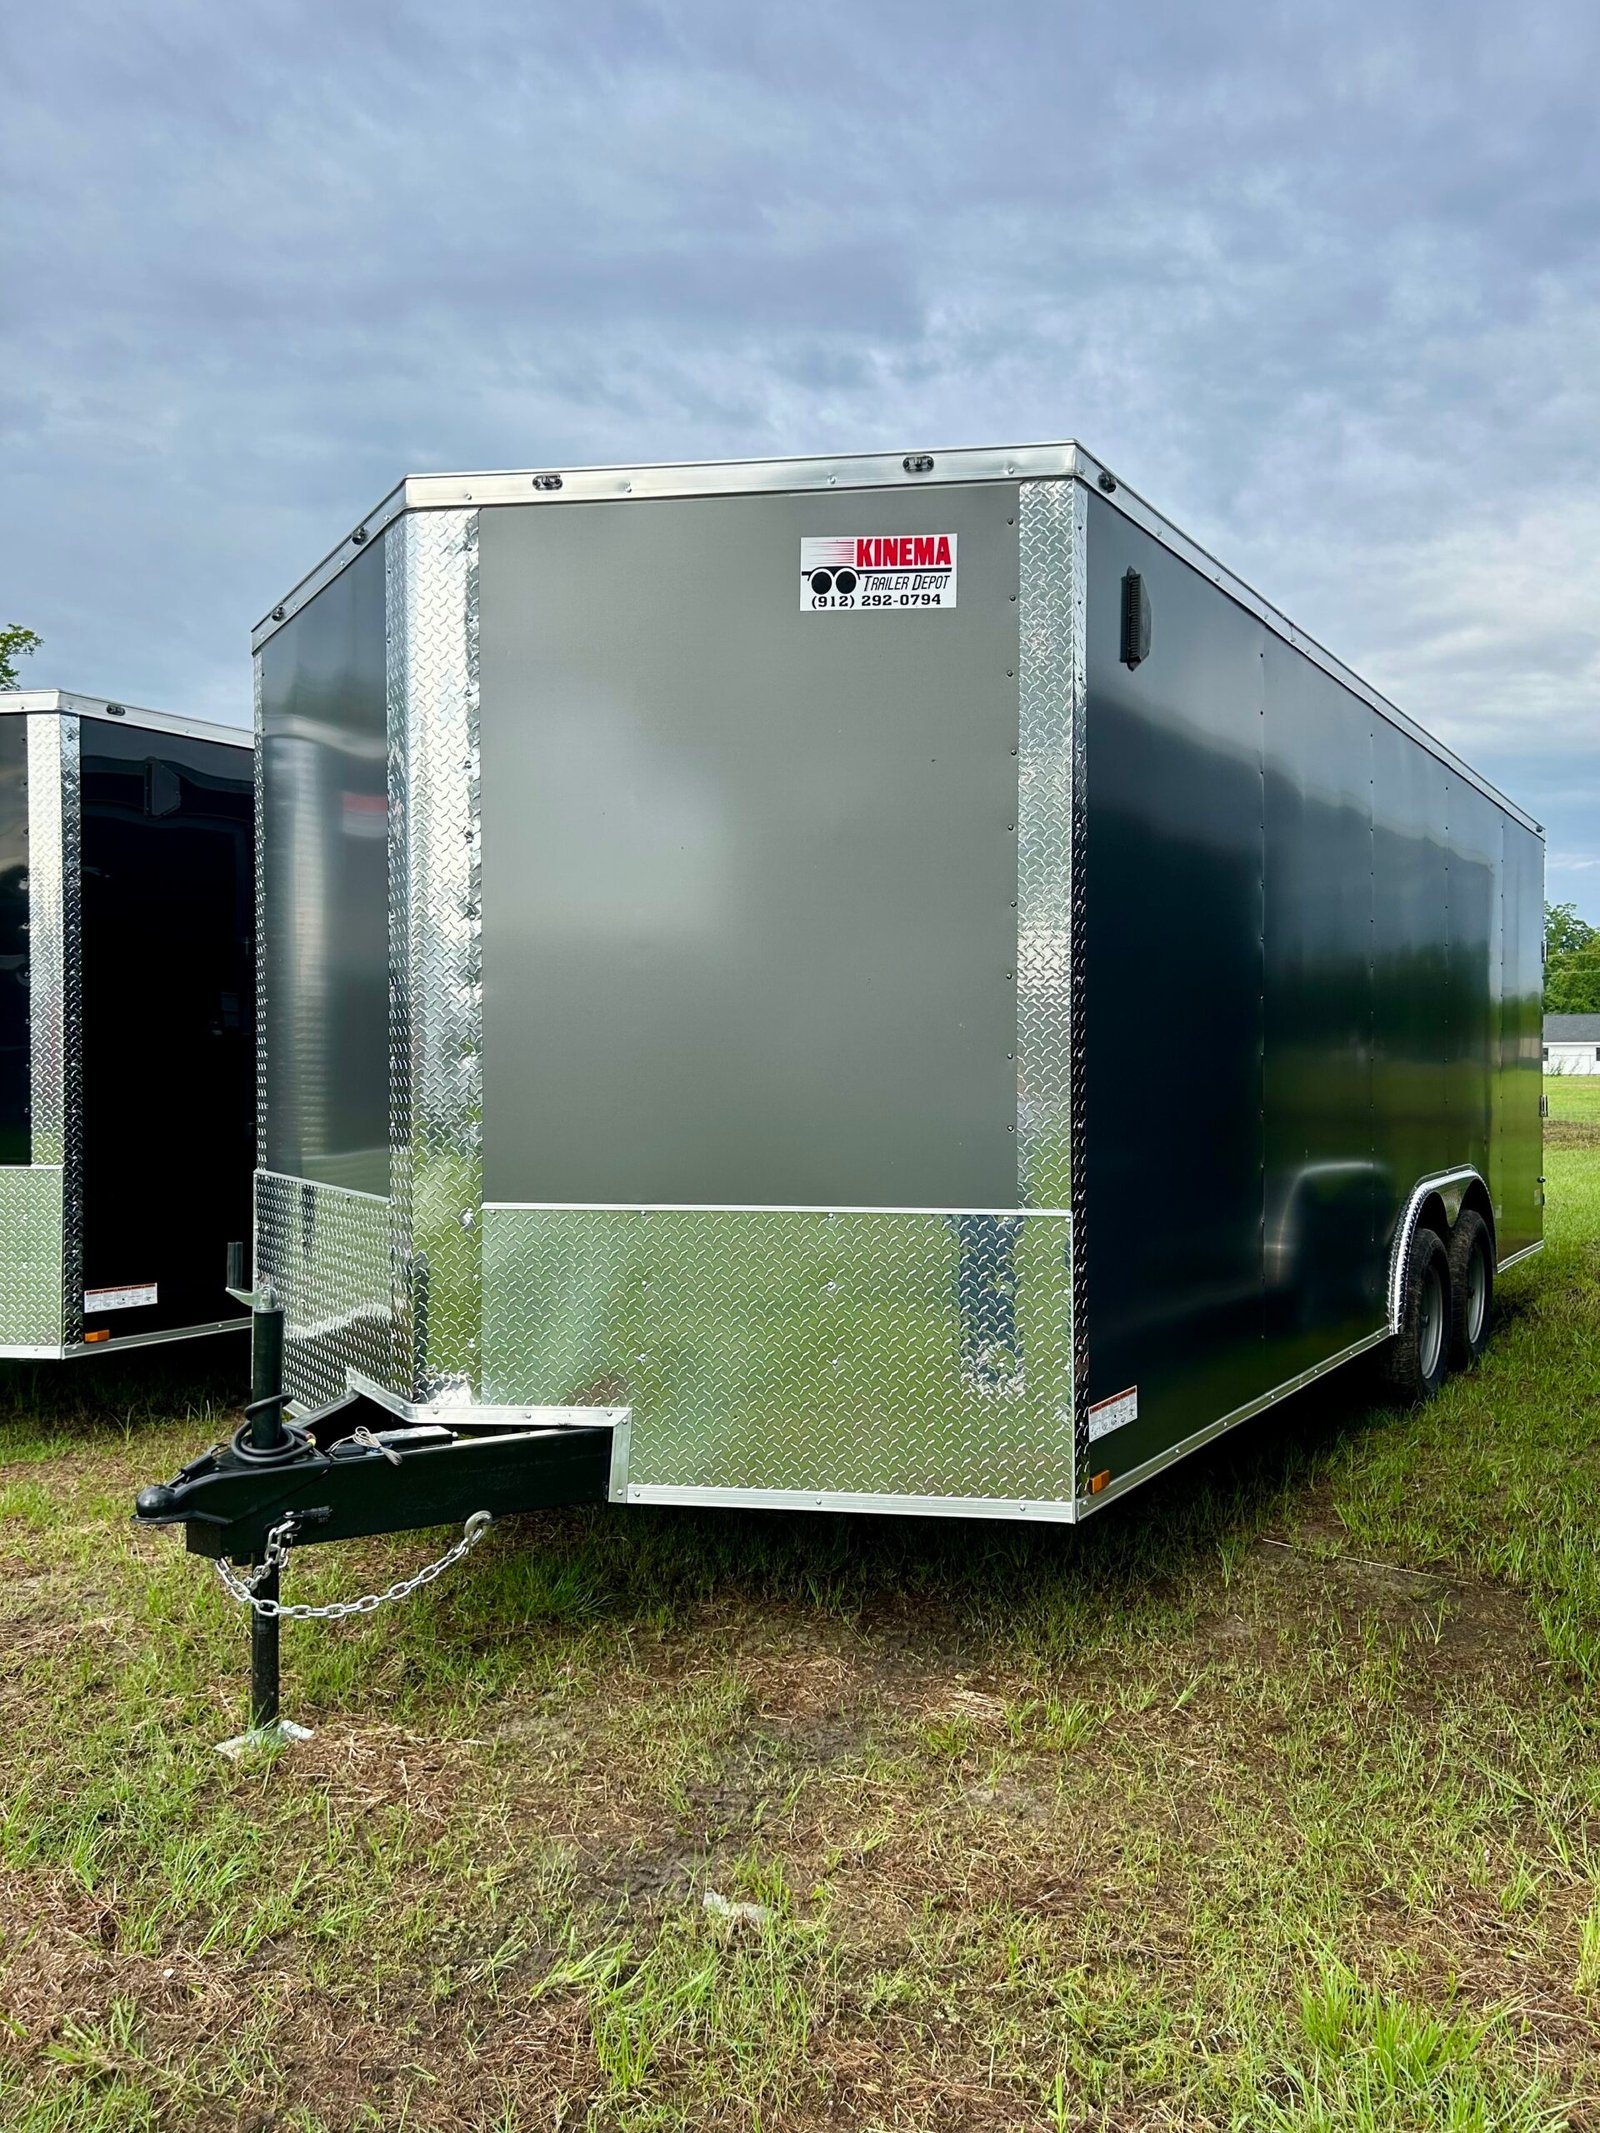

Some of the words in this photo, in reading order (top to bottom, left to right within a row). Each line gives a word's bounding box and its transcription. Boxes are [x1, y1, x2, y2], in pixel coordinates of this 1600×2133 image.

[857, 537, 951, 567] KINEMA
[863, 575, 909, 592] TRAILER
[912, 575, 950, 591] DEPOT
[811, 595, 855, 609] (912)
[861, 594, 941, 606] 292-0794
